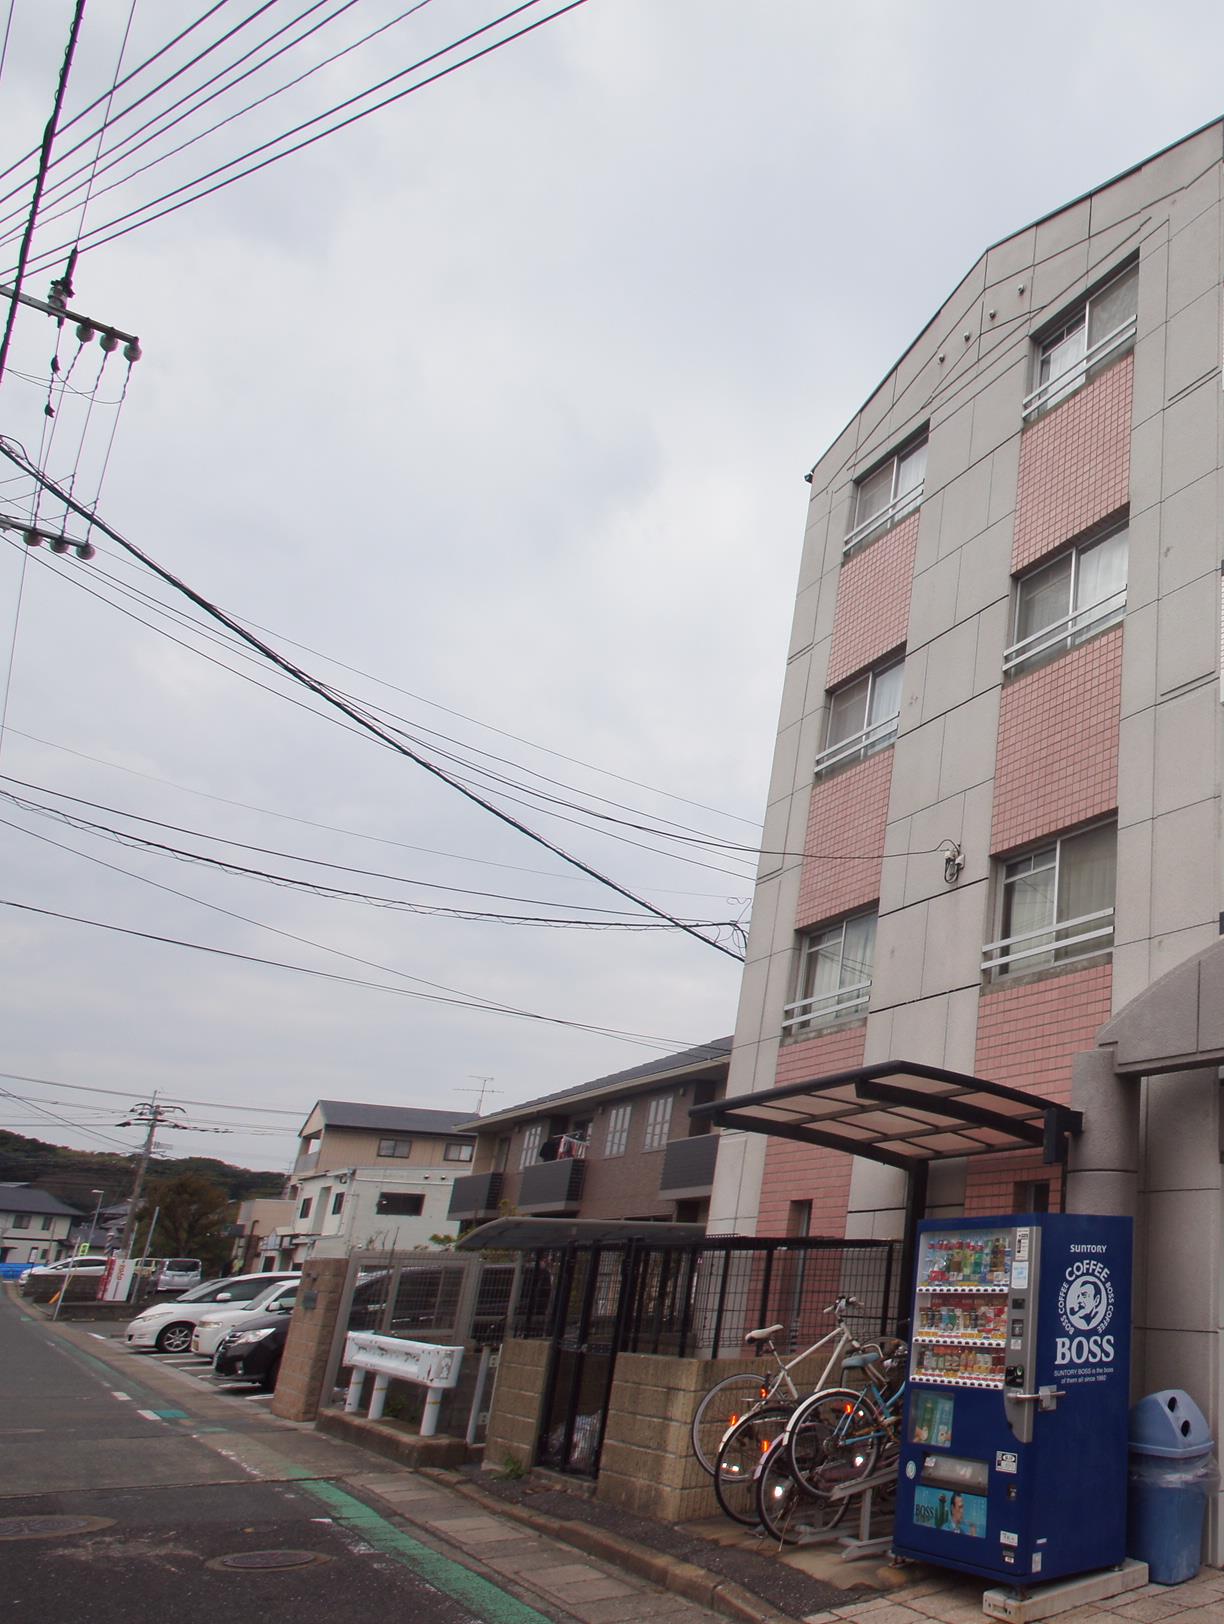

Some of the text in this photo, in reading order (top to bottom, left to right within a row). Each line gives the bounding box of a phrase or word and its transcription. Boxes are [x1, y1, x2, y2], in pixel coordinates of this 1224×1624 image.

[1069, 1243, 1107, 1254] SUNTORY
[1065, 1259, 1110, 1281] COFFEE
[1058, 1281, 1075, 1335] BOSS COFFEE
[1097, 1281, 1115, 1333] BOSS COFFEE
[1054, 1335, 1115, 1365] BOSS
[915, 1503, 935, 1519] BOSS
